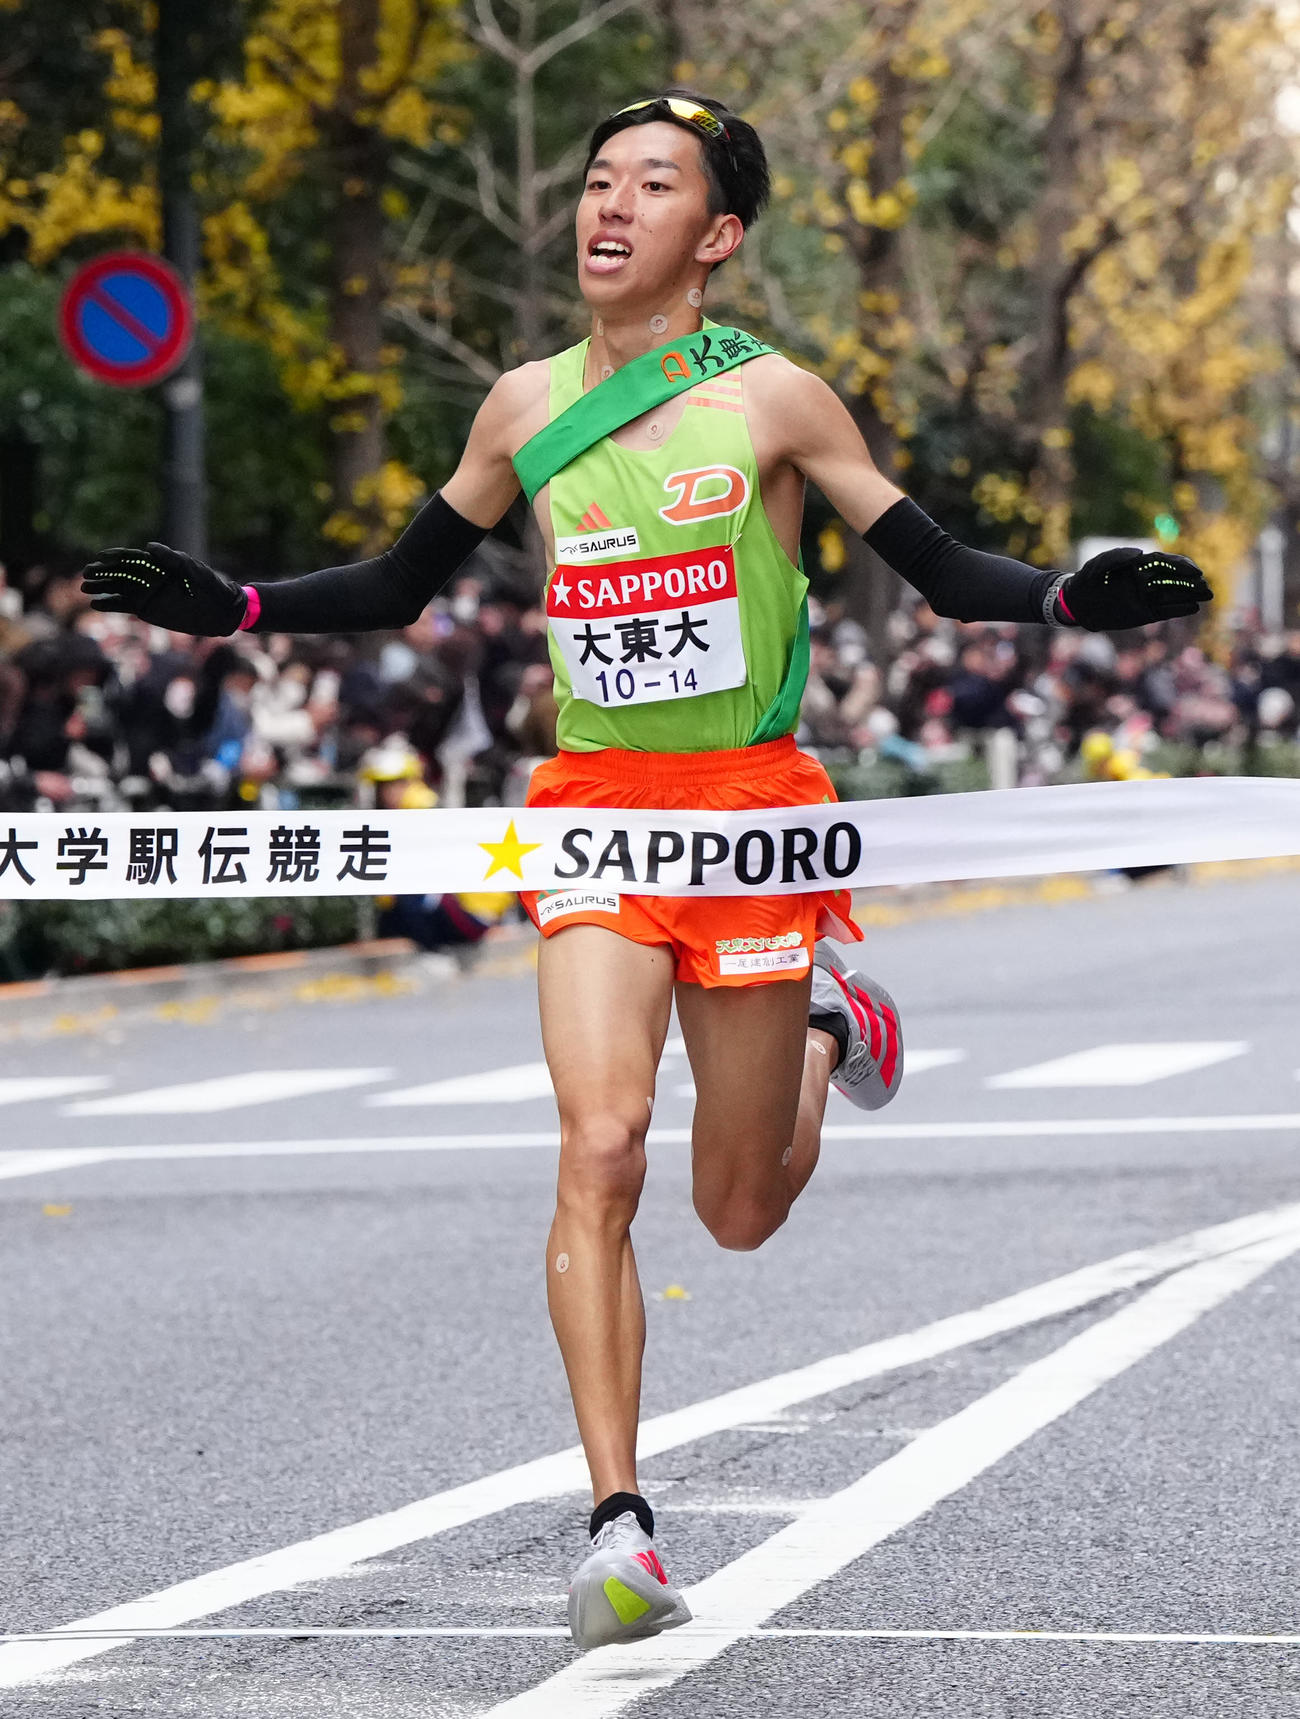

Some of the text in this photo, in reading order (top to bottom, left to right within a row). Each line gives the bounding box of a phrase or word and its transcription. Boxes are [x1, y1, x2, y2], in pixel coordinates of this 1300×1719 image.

[658, 463, 749, 526] D
[578, 534, 637, 554] SAURUS
[577, 560, 728, 609] SAPPORO
[573, 611, 711, 667] 大東大
[0, 824, 391, 886] 大学駅伝競走
[554, 821, 862, 886] SAPPORO
[555, 895, 617, 910] SAURUS
